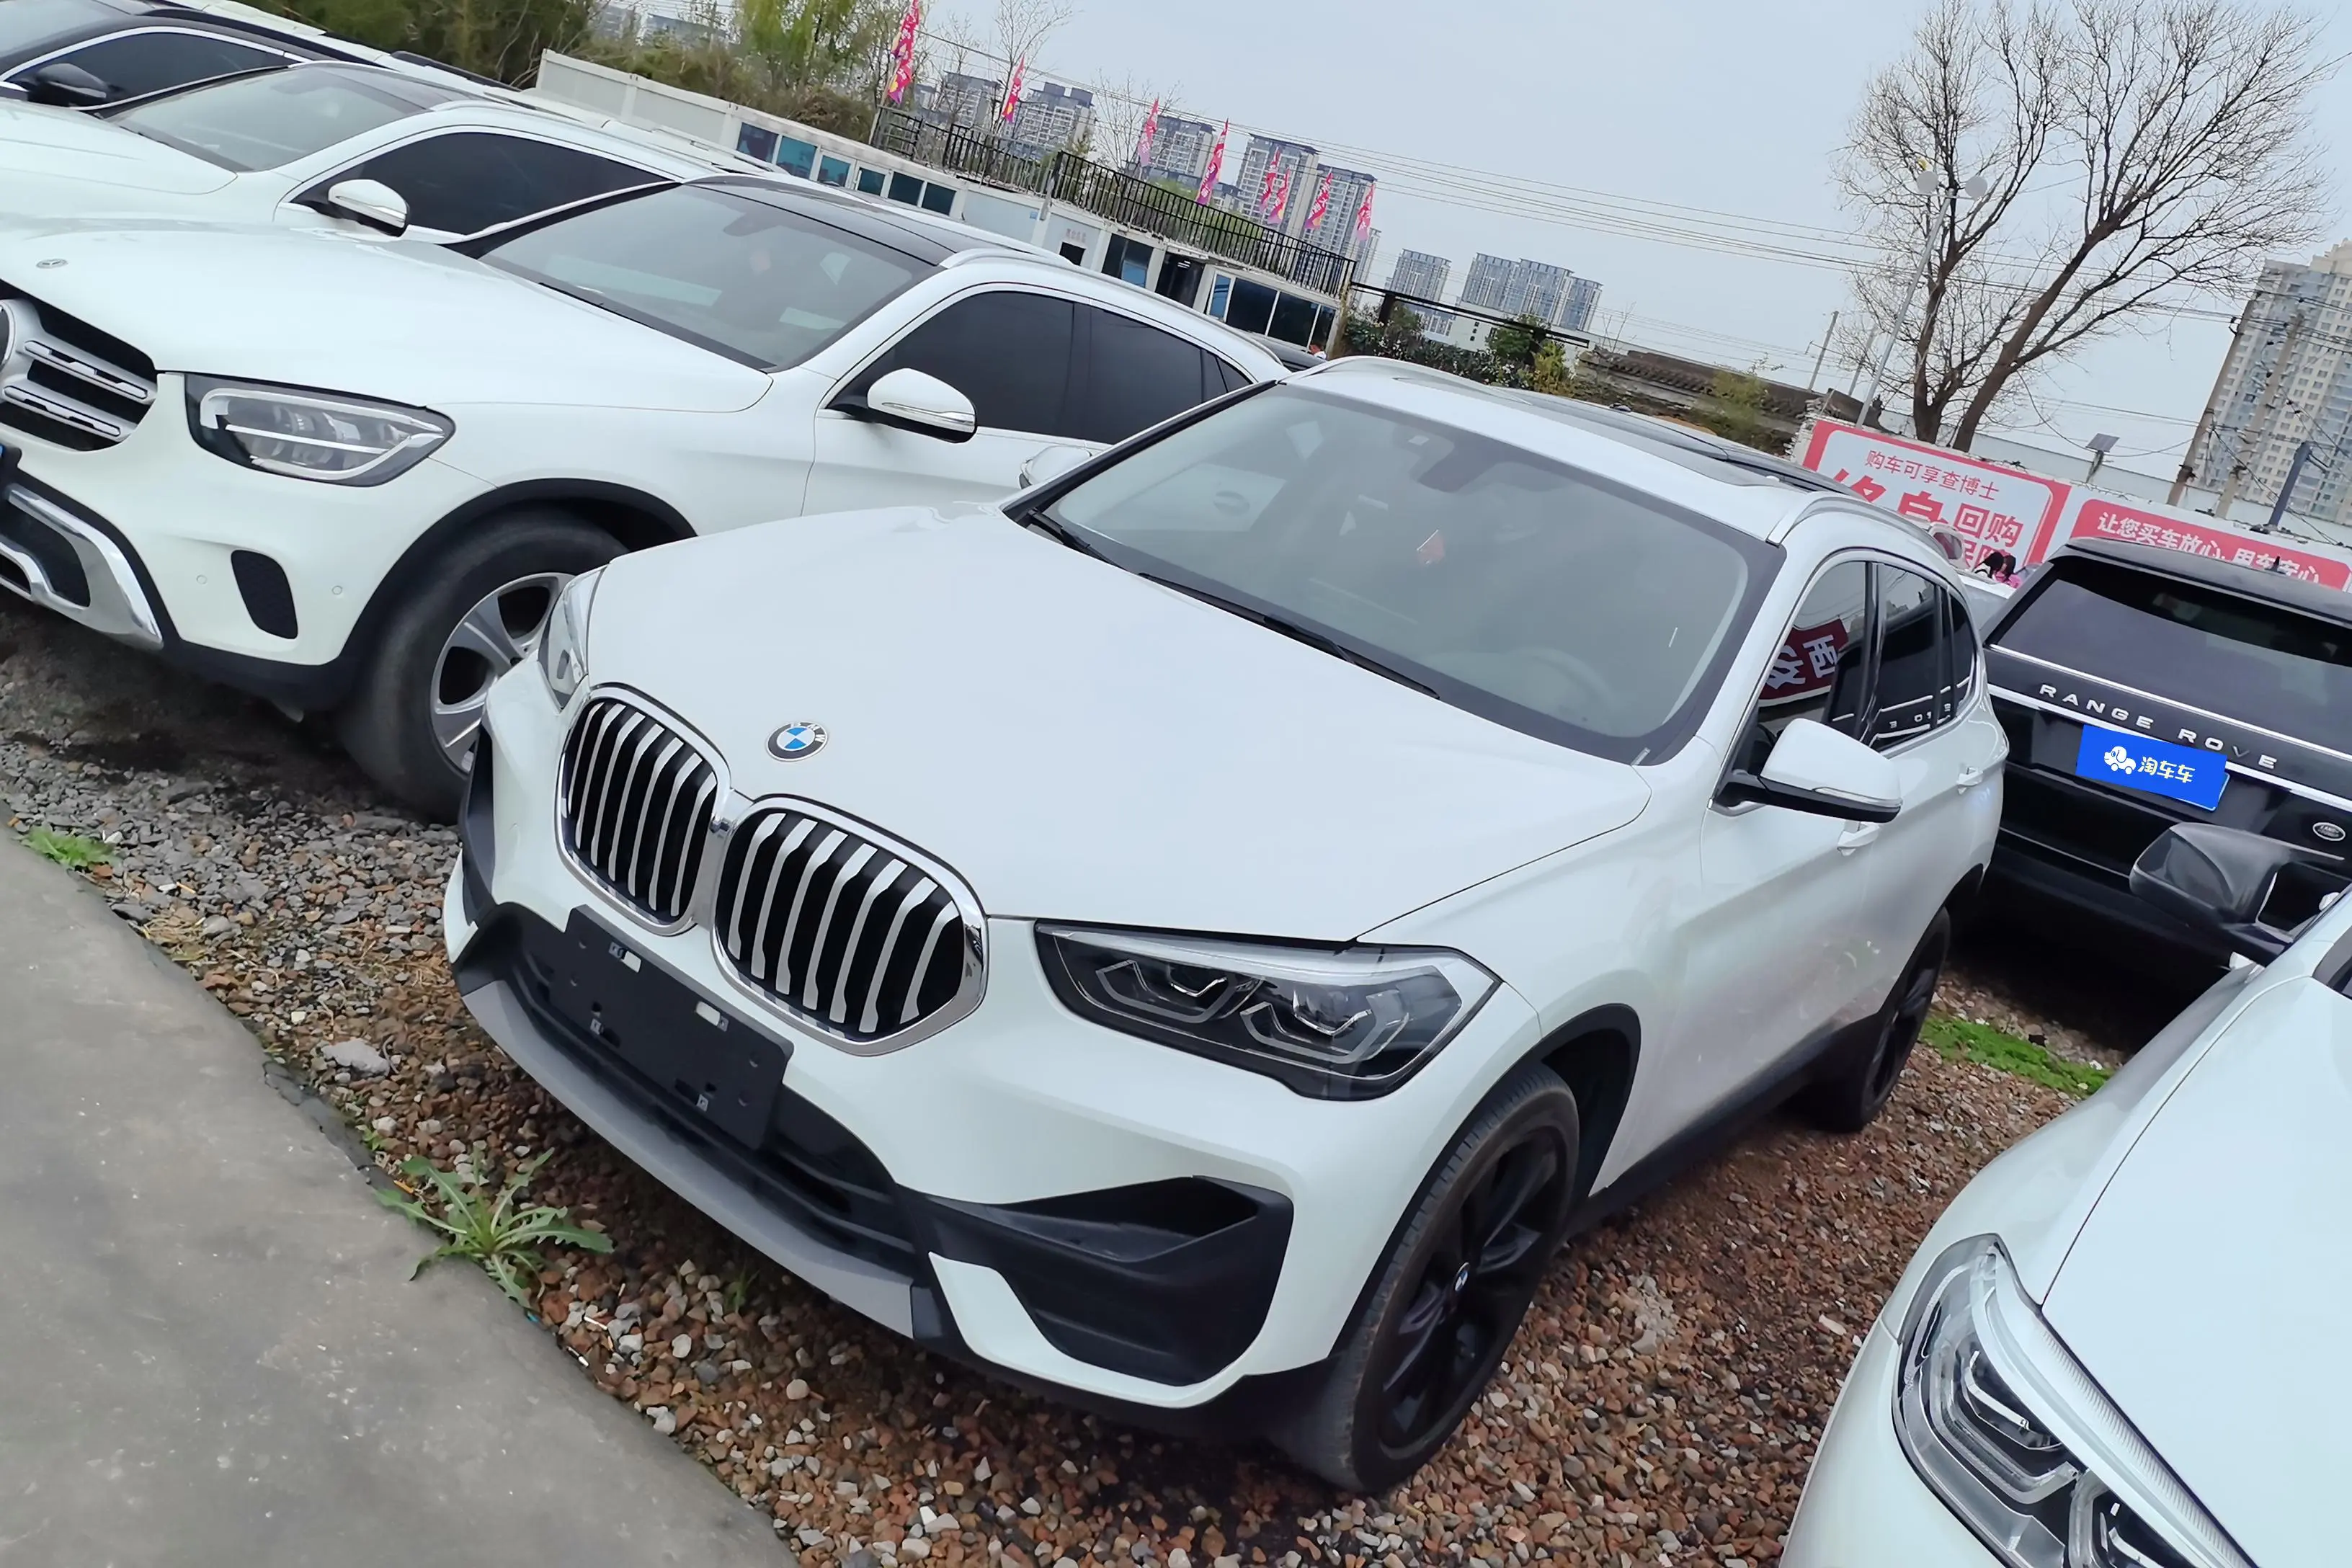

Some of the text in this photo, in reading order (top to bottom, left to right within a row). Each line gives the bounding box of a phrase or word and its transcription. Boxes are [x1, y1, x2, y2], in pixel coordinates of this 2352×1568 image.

[1865, 450, 1999, 501] 购车可享查博士
[2039, 684, 2277, 769] RANGE ROVE
